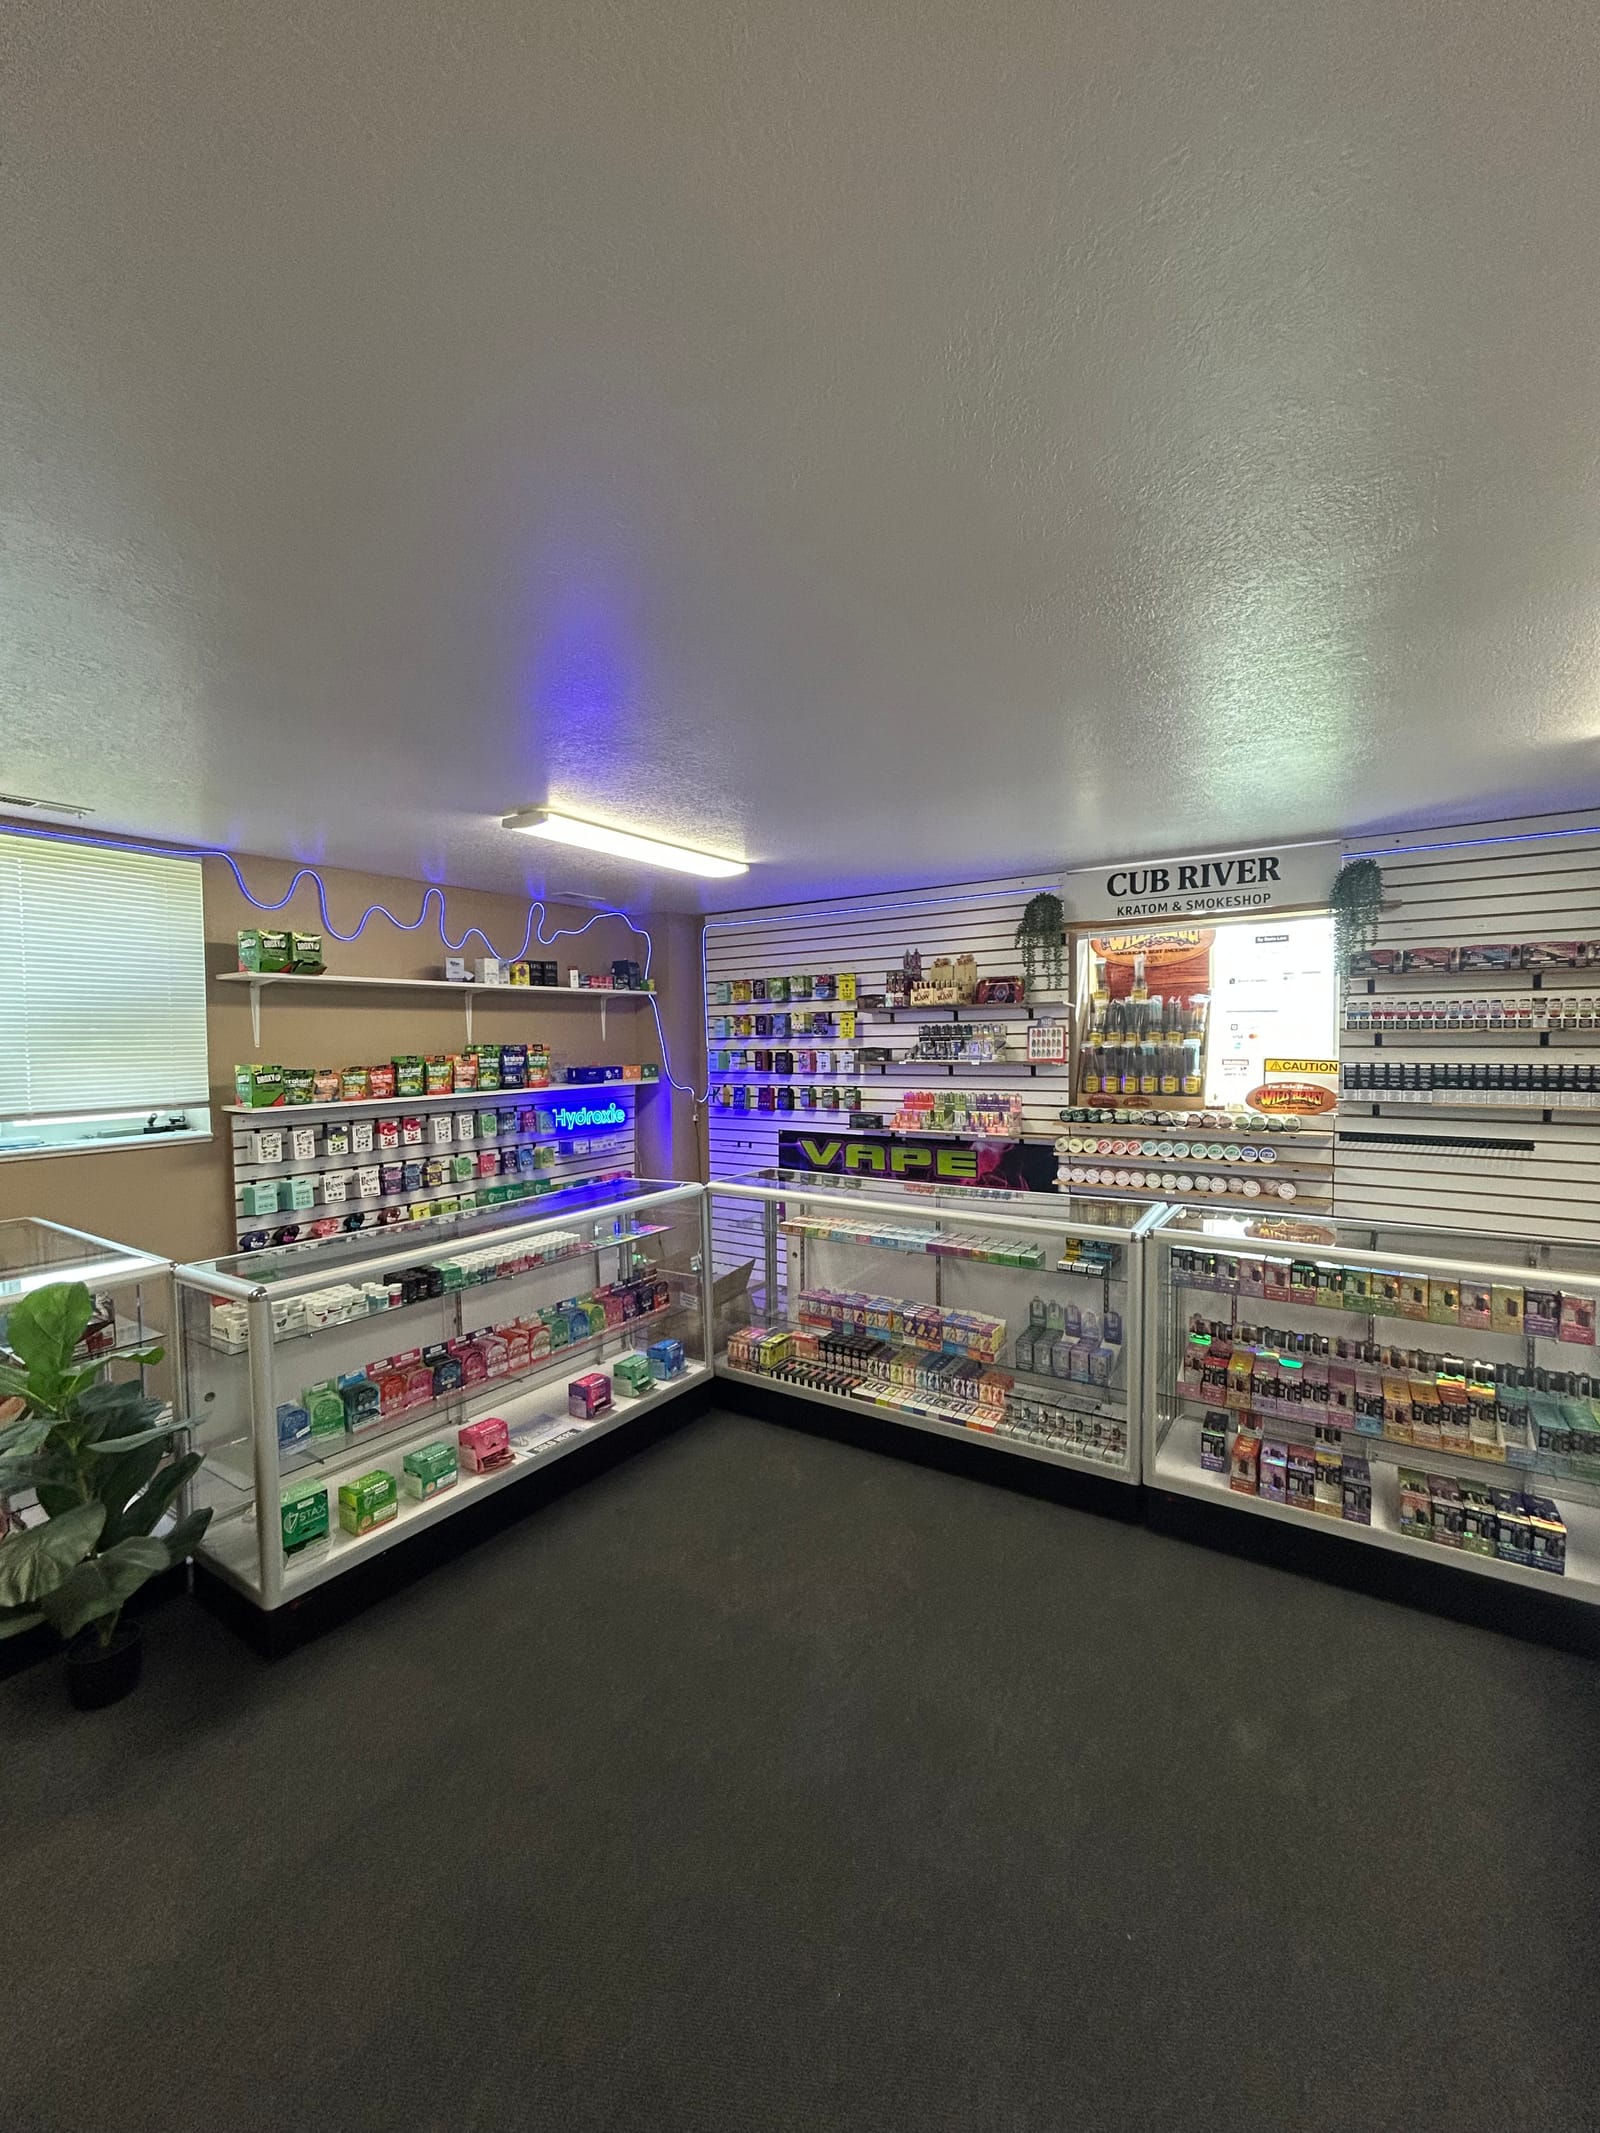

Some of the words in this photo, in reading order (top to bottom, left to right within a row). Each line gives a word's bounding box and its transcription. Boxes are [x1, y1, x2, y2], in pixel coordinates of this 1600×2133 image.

[1107, 868, 1170, 897] CUB
[1177, 856, 1281, 890] RIVER
[1116, 902, 1168, 916] KRATOM
[1172, 902, 1182, 911] &
[1186, 893, 1271, 911] SMOKESHOP
[1282, 1061, 1338, 1072] CAUTION
[1260, 1090, 1289, 1105] WILD
[1291, 1090, 1324, 1106] BERRY
[552, 1102, 626, 1130] Hydroxie
[800, 1139, 977, 1178] VAPE
